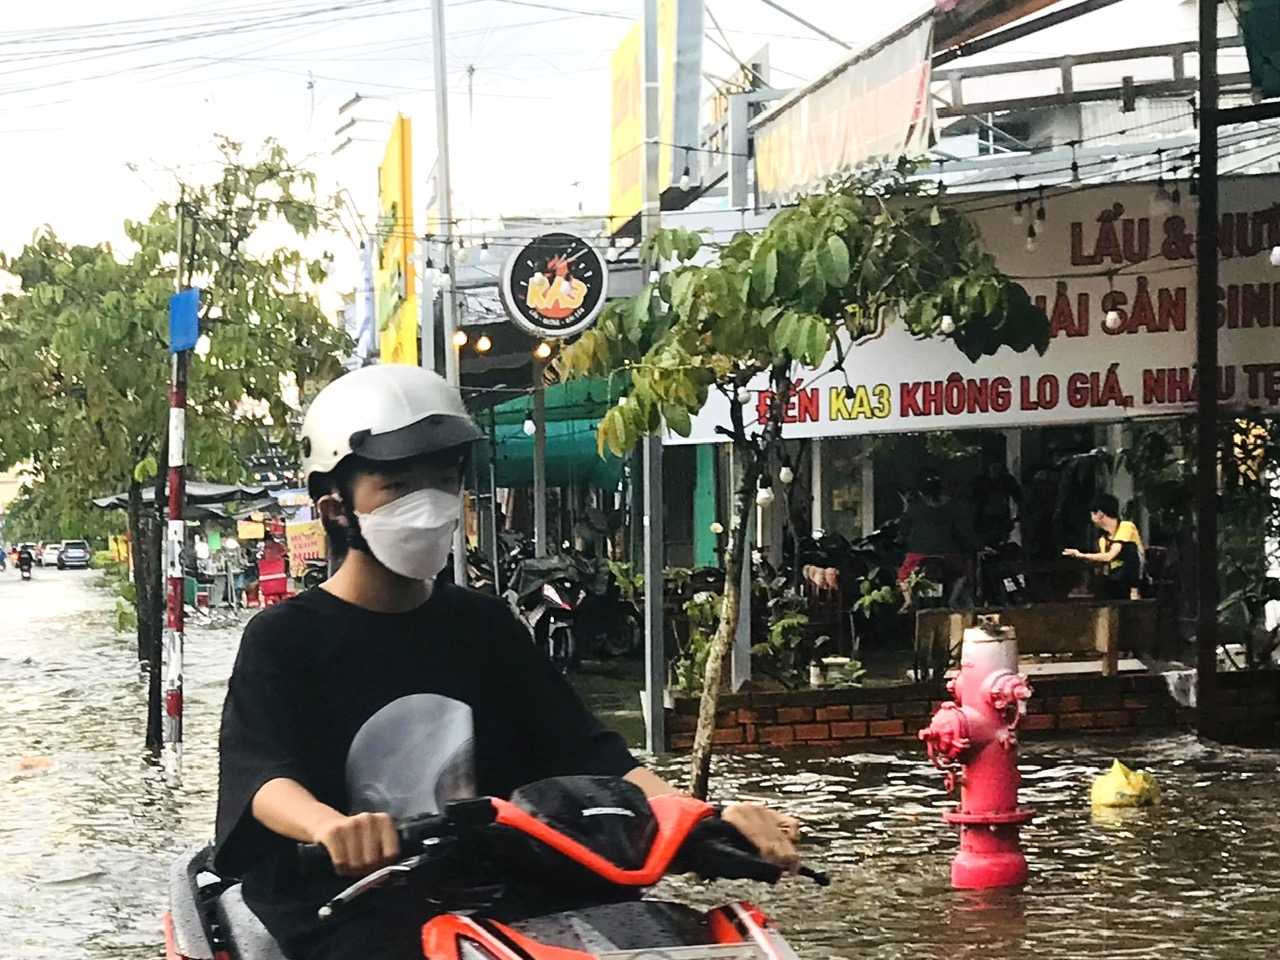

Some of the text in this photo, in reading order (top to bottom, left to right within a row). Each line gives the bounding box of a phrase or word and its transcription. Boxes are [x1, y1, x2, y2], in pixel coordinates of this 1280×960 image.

[1070, 202, 1150, 266] LẨU
[1161, 215, 1195, 260] &
[1034, 280, 1090, 338] ẢI
[1101, 275, 1187, 335] SẢN
[829, 383, 892, 422] KA3
[899, 371, 1013, 418] KHÔNG
[1020, 374, 1060, 411] LO
